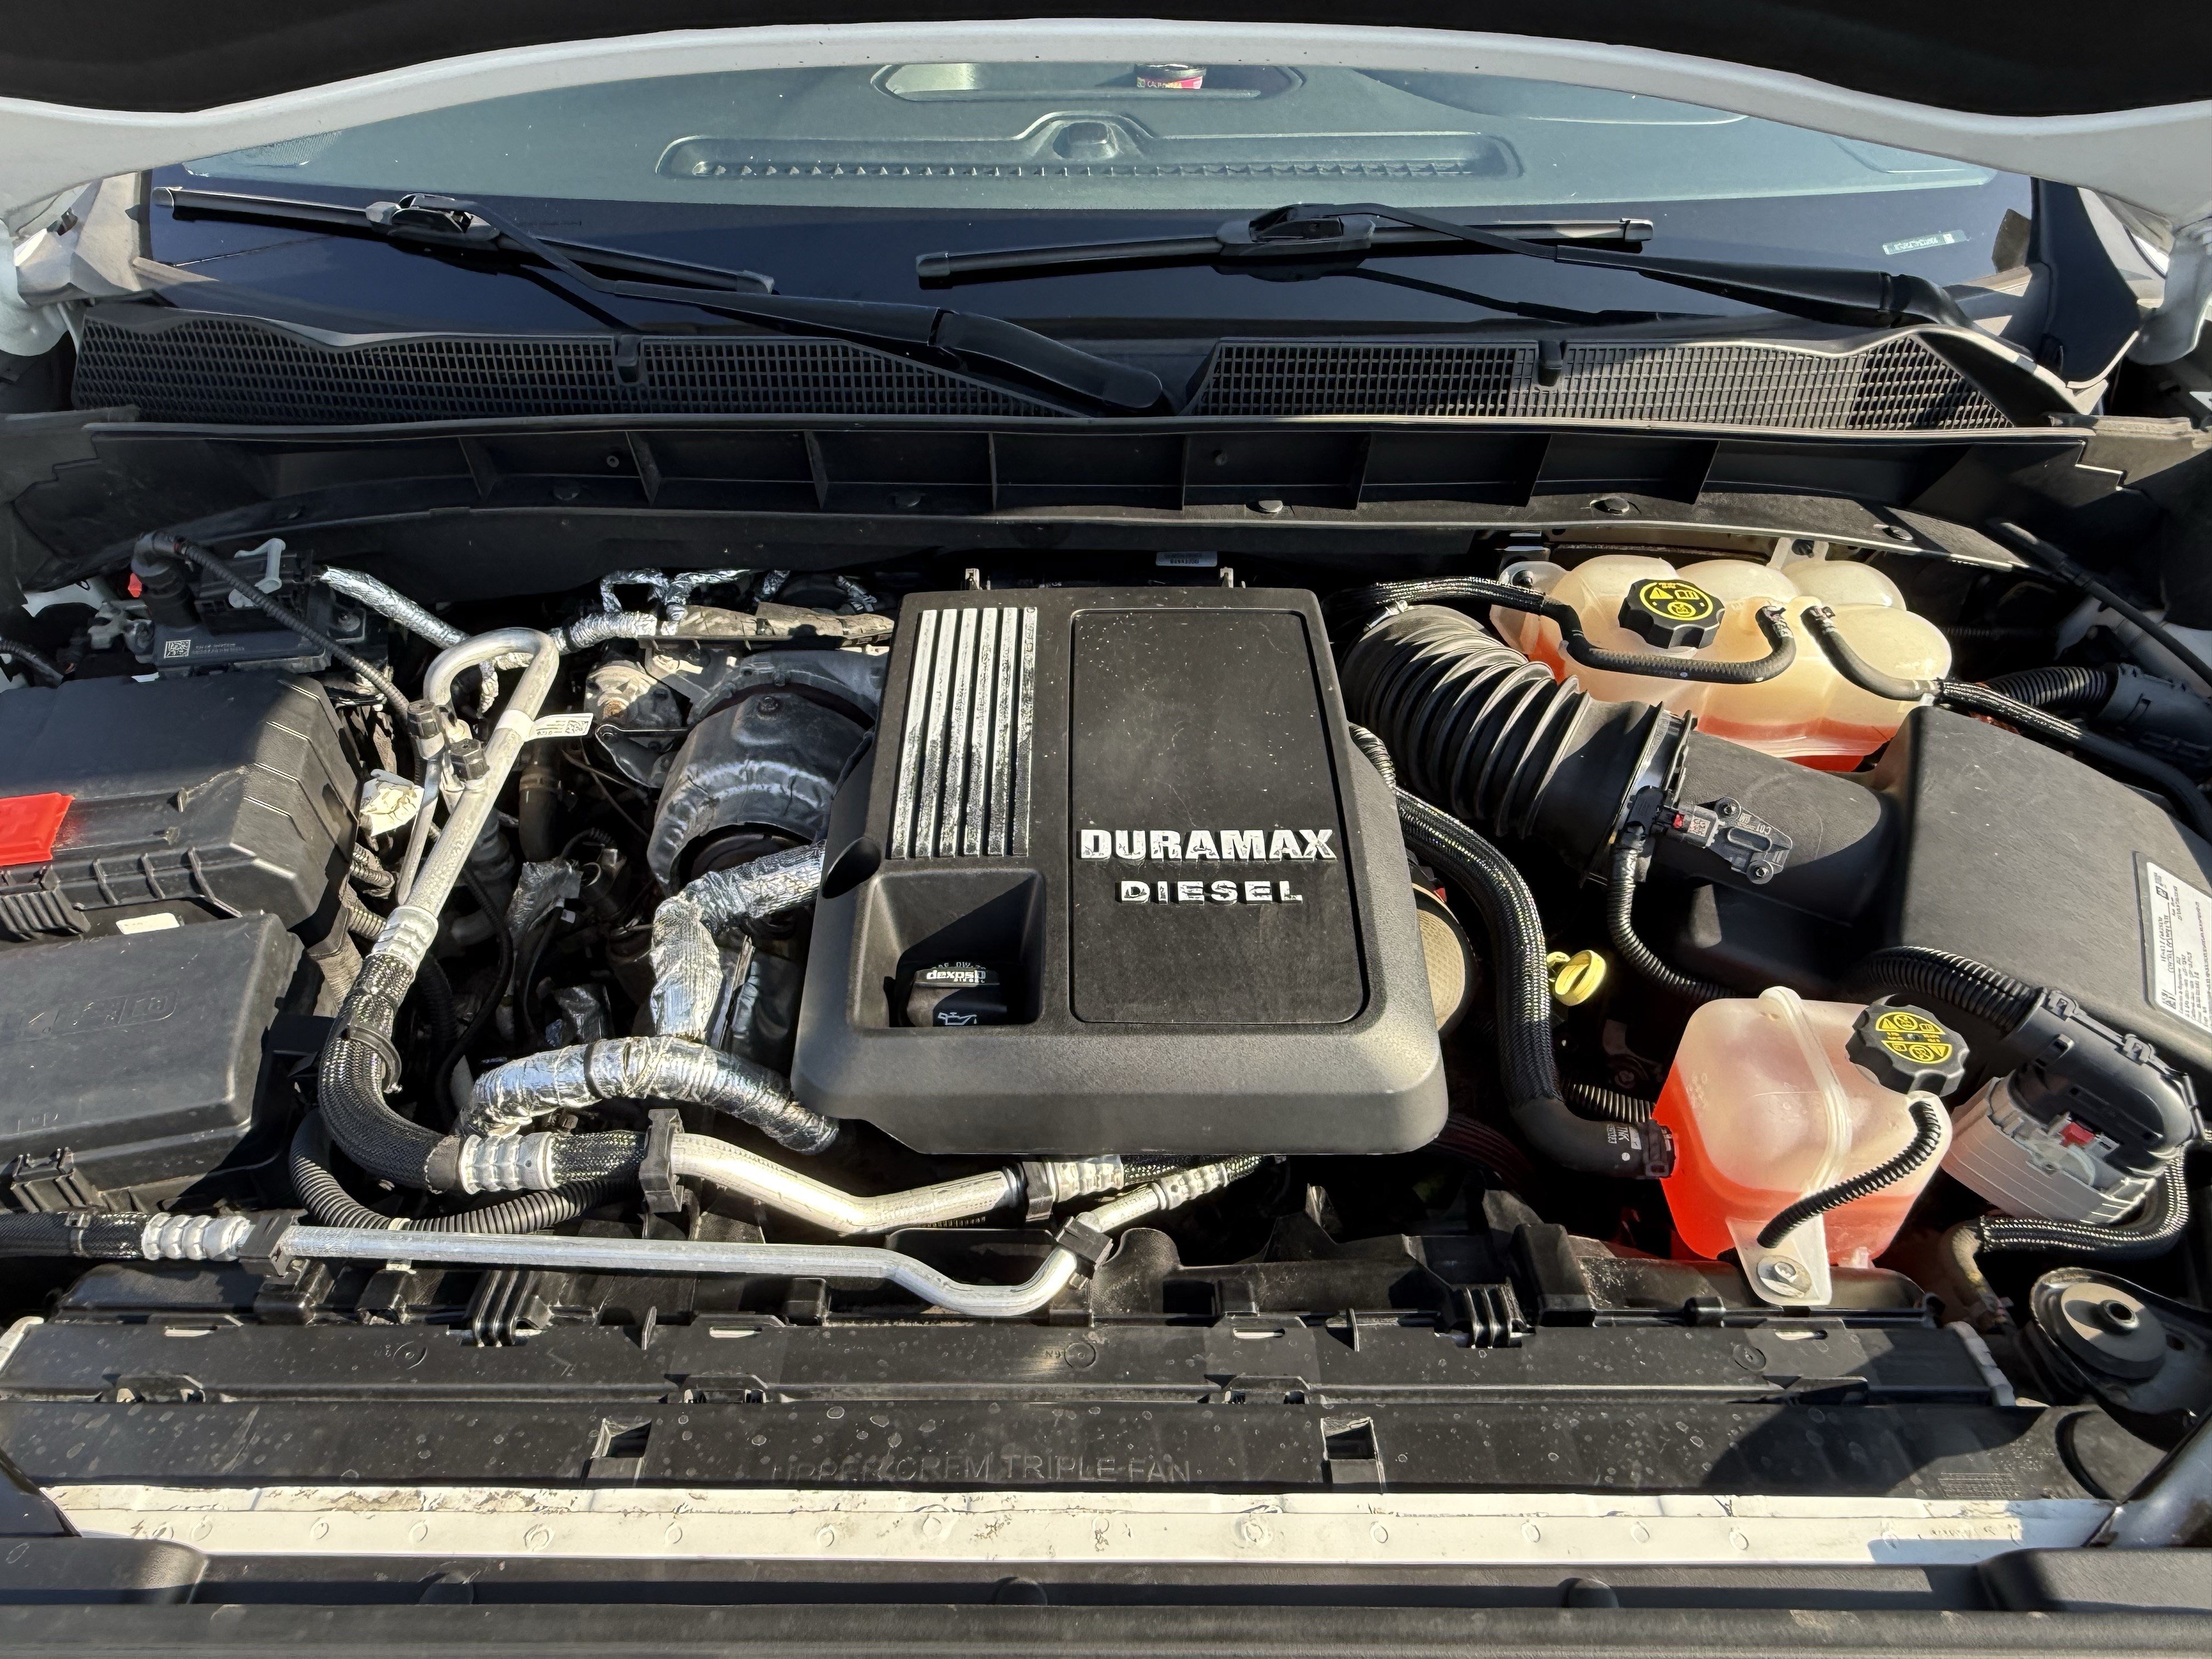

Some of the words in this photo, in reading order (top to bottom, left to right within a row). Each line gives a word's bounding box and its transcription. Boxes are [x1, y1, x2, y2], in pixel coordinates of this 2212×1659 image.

[1081, 829, 1337, 860] DURAMAX
[1121, 881, 1303, 903] DIESEL
[1001, 1454, 1117, 1481] TRIPLE
[1128, 1455, 1190, 1482] FAN
